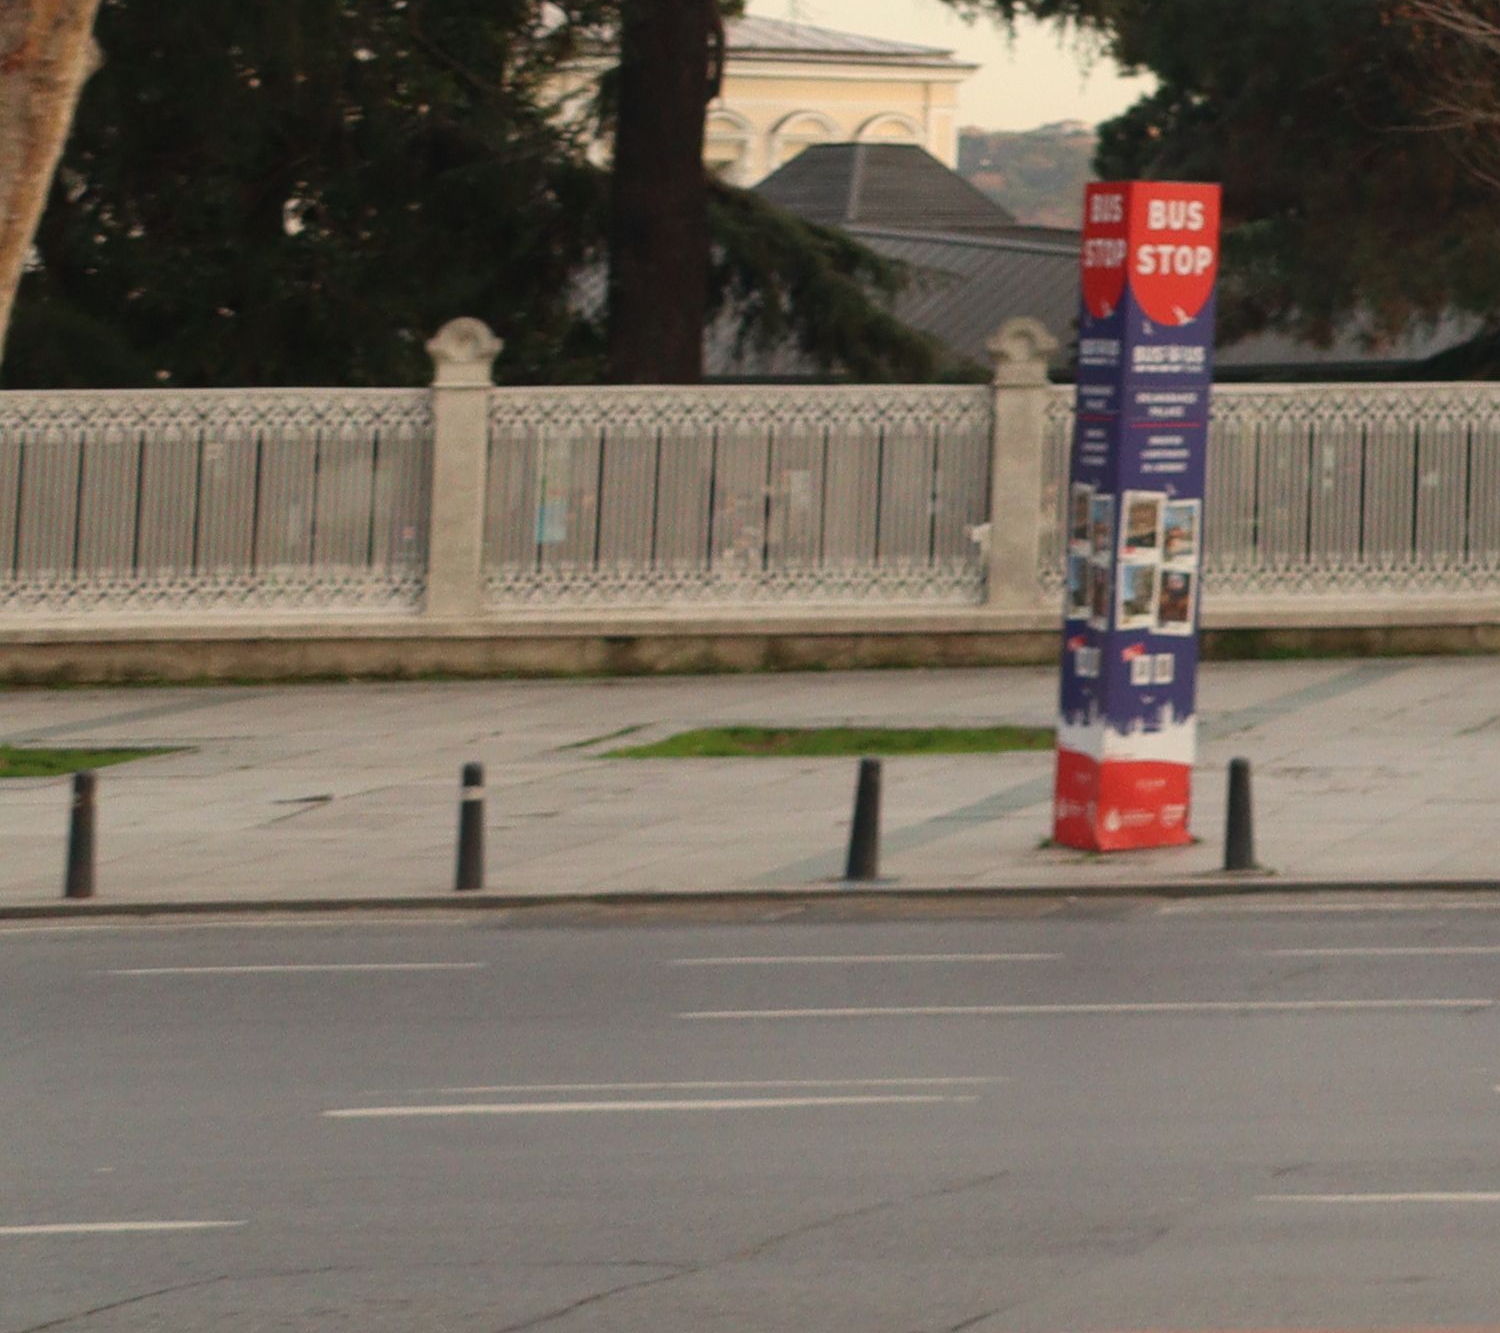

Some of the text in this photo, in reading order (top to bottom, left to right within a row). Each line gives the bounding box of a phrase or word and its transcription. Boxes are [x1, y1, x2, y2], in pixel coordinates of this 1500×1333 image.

[1091, 193, 1123, 222] BUS
[1147, 199, 1204, 231] BUS
[1084, 238, 1128, 268] STOP
[1136, 244, 1213, 276] STOP
